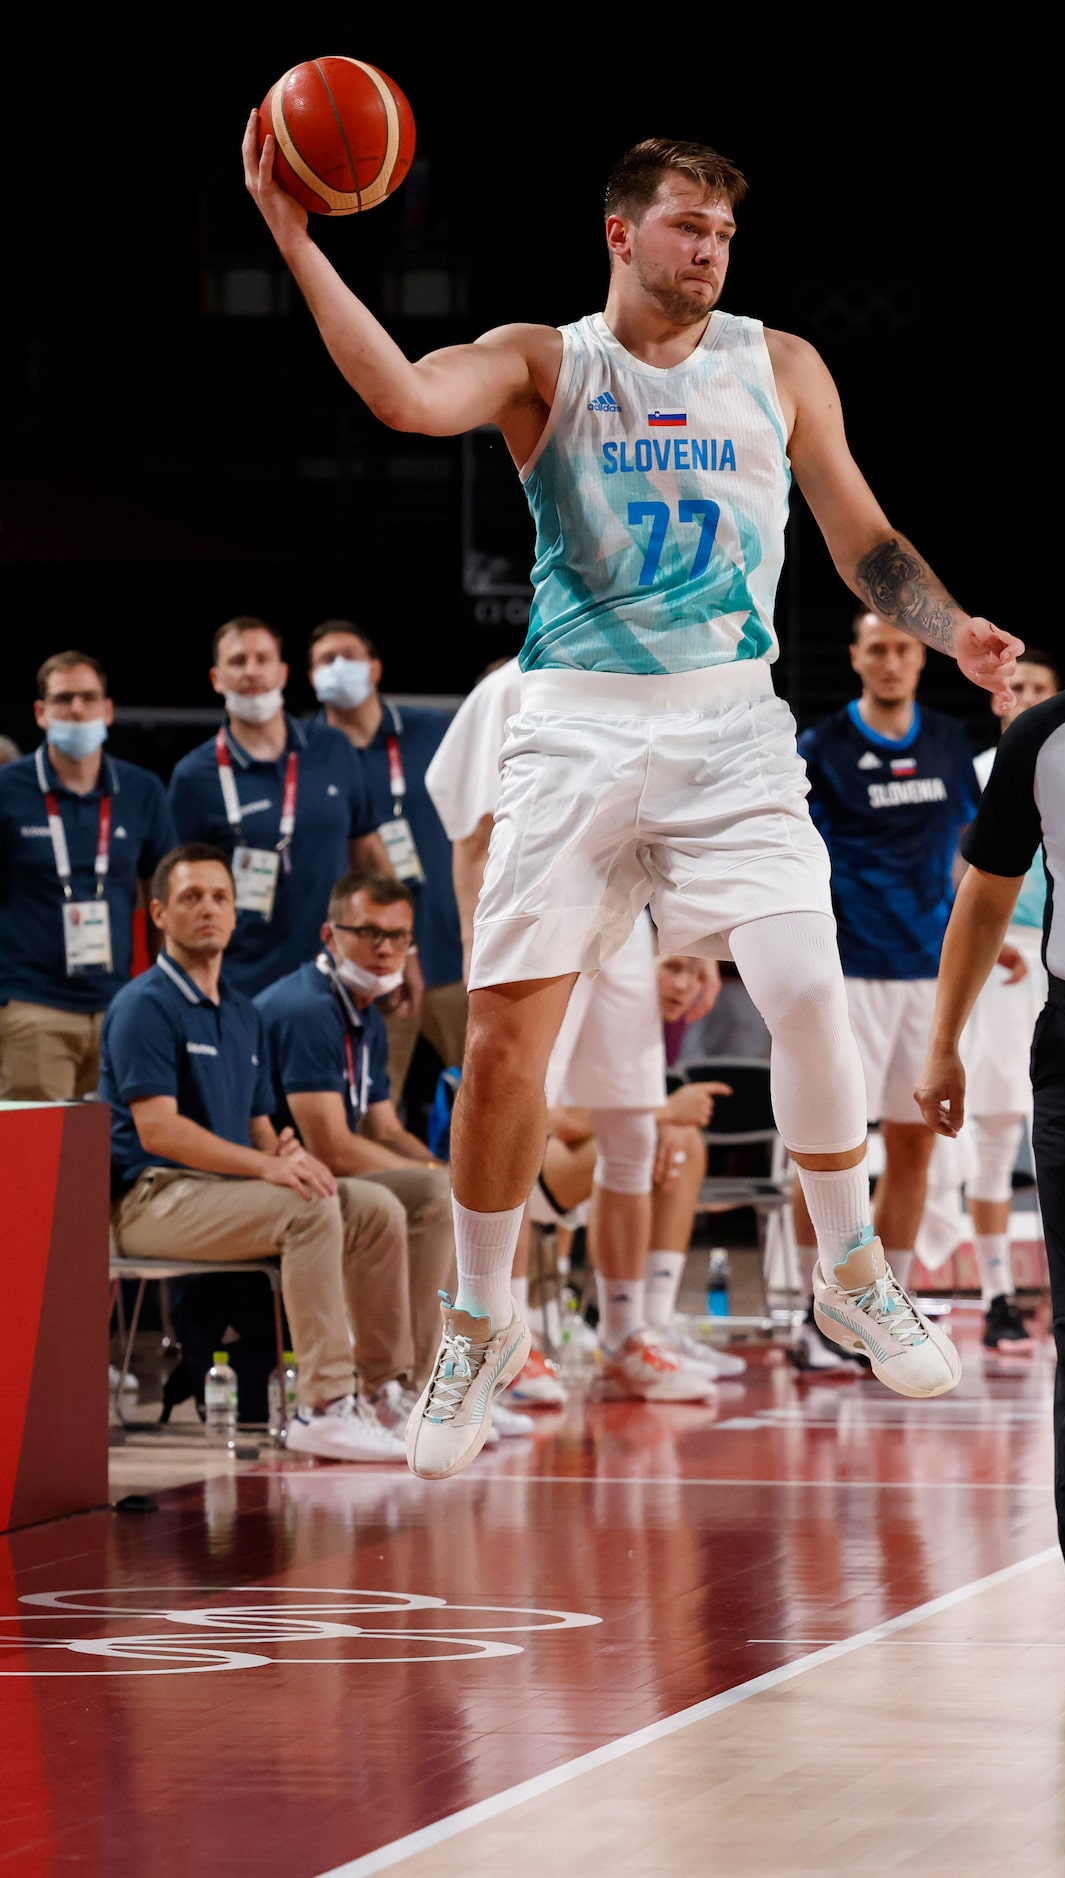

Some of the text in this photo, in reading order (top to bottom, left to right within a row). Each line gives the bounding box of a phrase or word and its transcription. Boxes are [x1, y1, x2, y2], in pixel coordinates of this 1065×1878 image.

[587, 403, 622, 413] adidas
[602, 438, 737, 475] SLOVENIA
[627, 499, 720, 586] 77
